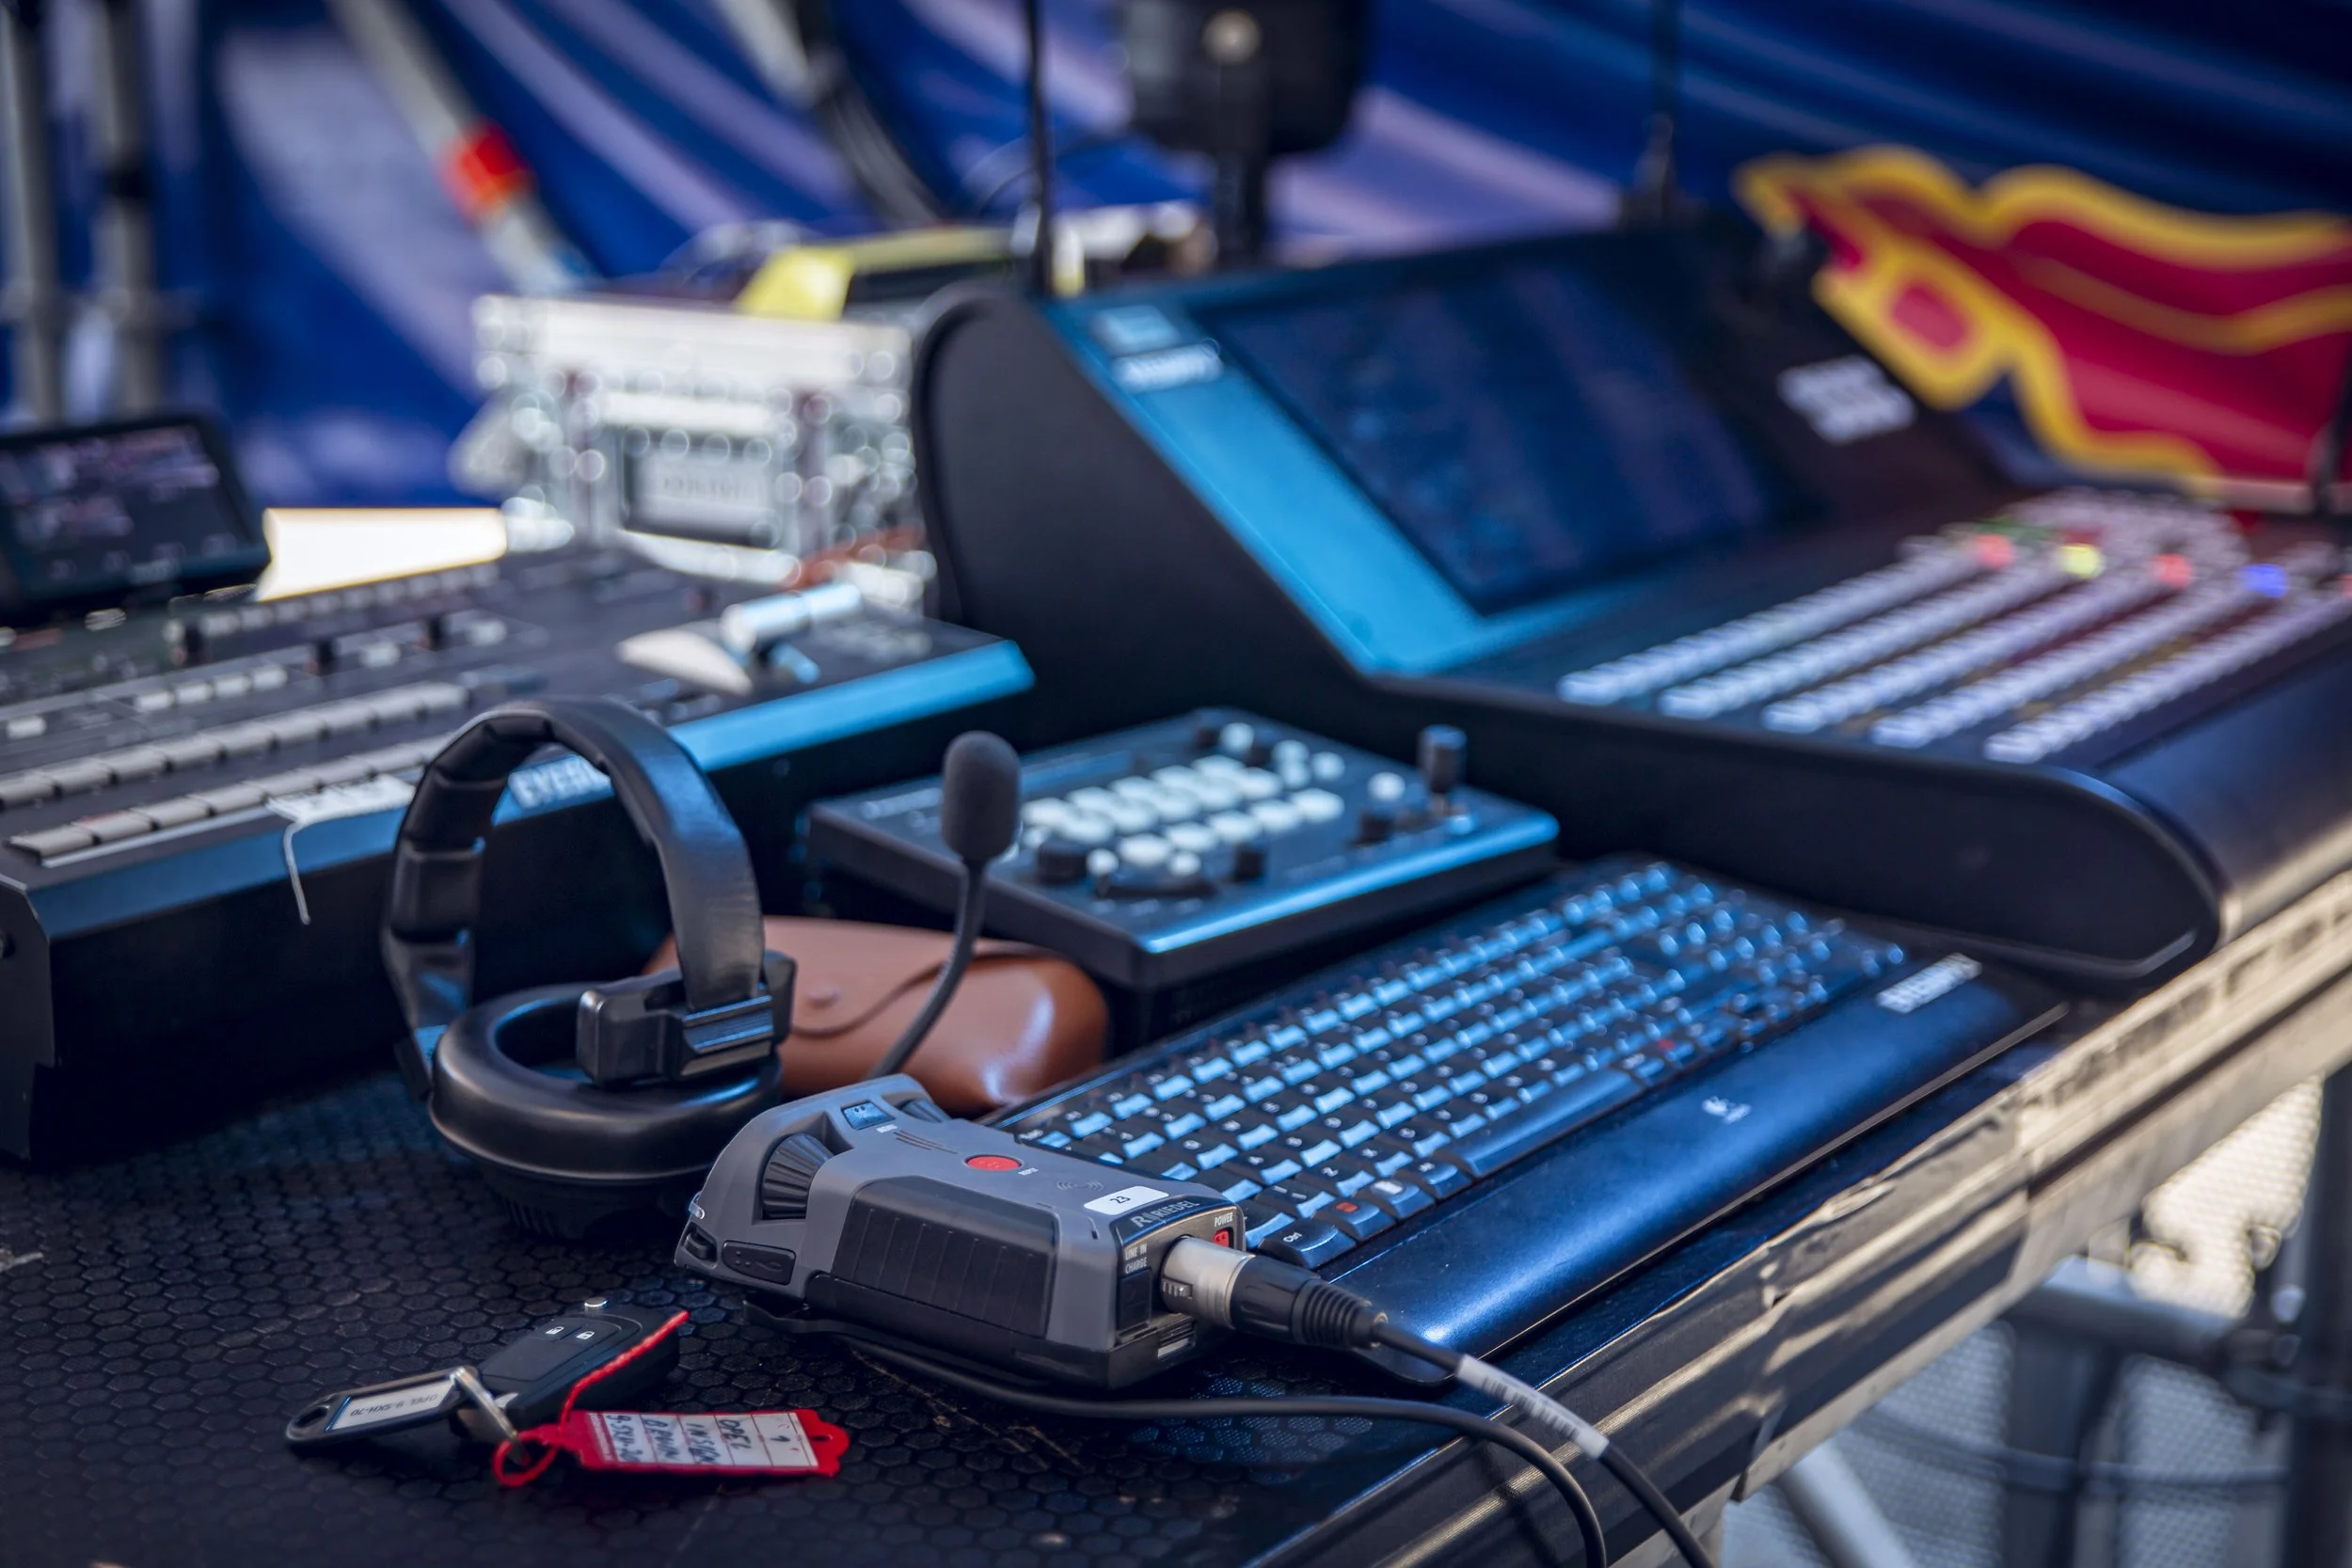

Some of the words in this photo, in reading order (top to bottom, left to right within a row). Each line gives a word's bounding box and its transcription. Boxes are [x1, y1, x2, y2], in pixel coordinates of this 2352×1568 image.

[1110, 1196, 1131, 1204] 23
[1151, 1200, 1200, 1218] RIEDEL
[1214, 1212, 1233, 1227] POWER
[1139, 1243, 1147, 1255] IN
[1124, 1257, 1148, 1275] CHARGE
[718, 1418, 752, 1449] OPEL
